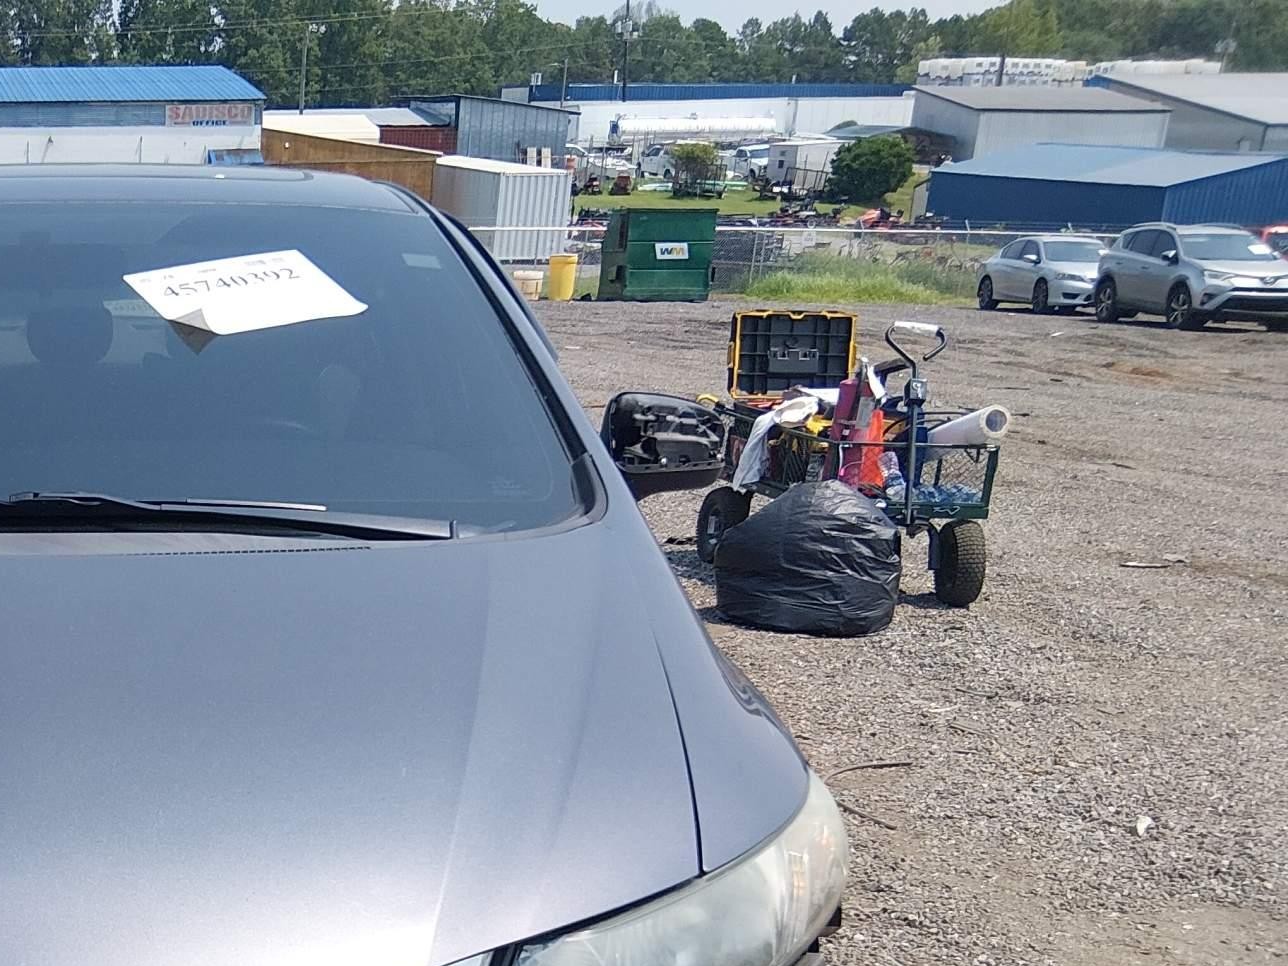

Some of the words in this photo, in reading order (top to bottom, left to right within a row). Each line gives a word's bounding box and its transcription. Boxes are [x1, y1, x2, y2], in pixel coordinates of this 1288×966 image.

[168, 105, 252, 120] SADISCO
[192, 119, 228, 127] OFFICE
[660, 247, 685, 256] WM
[163, 267, 300, 298] 45740392
